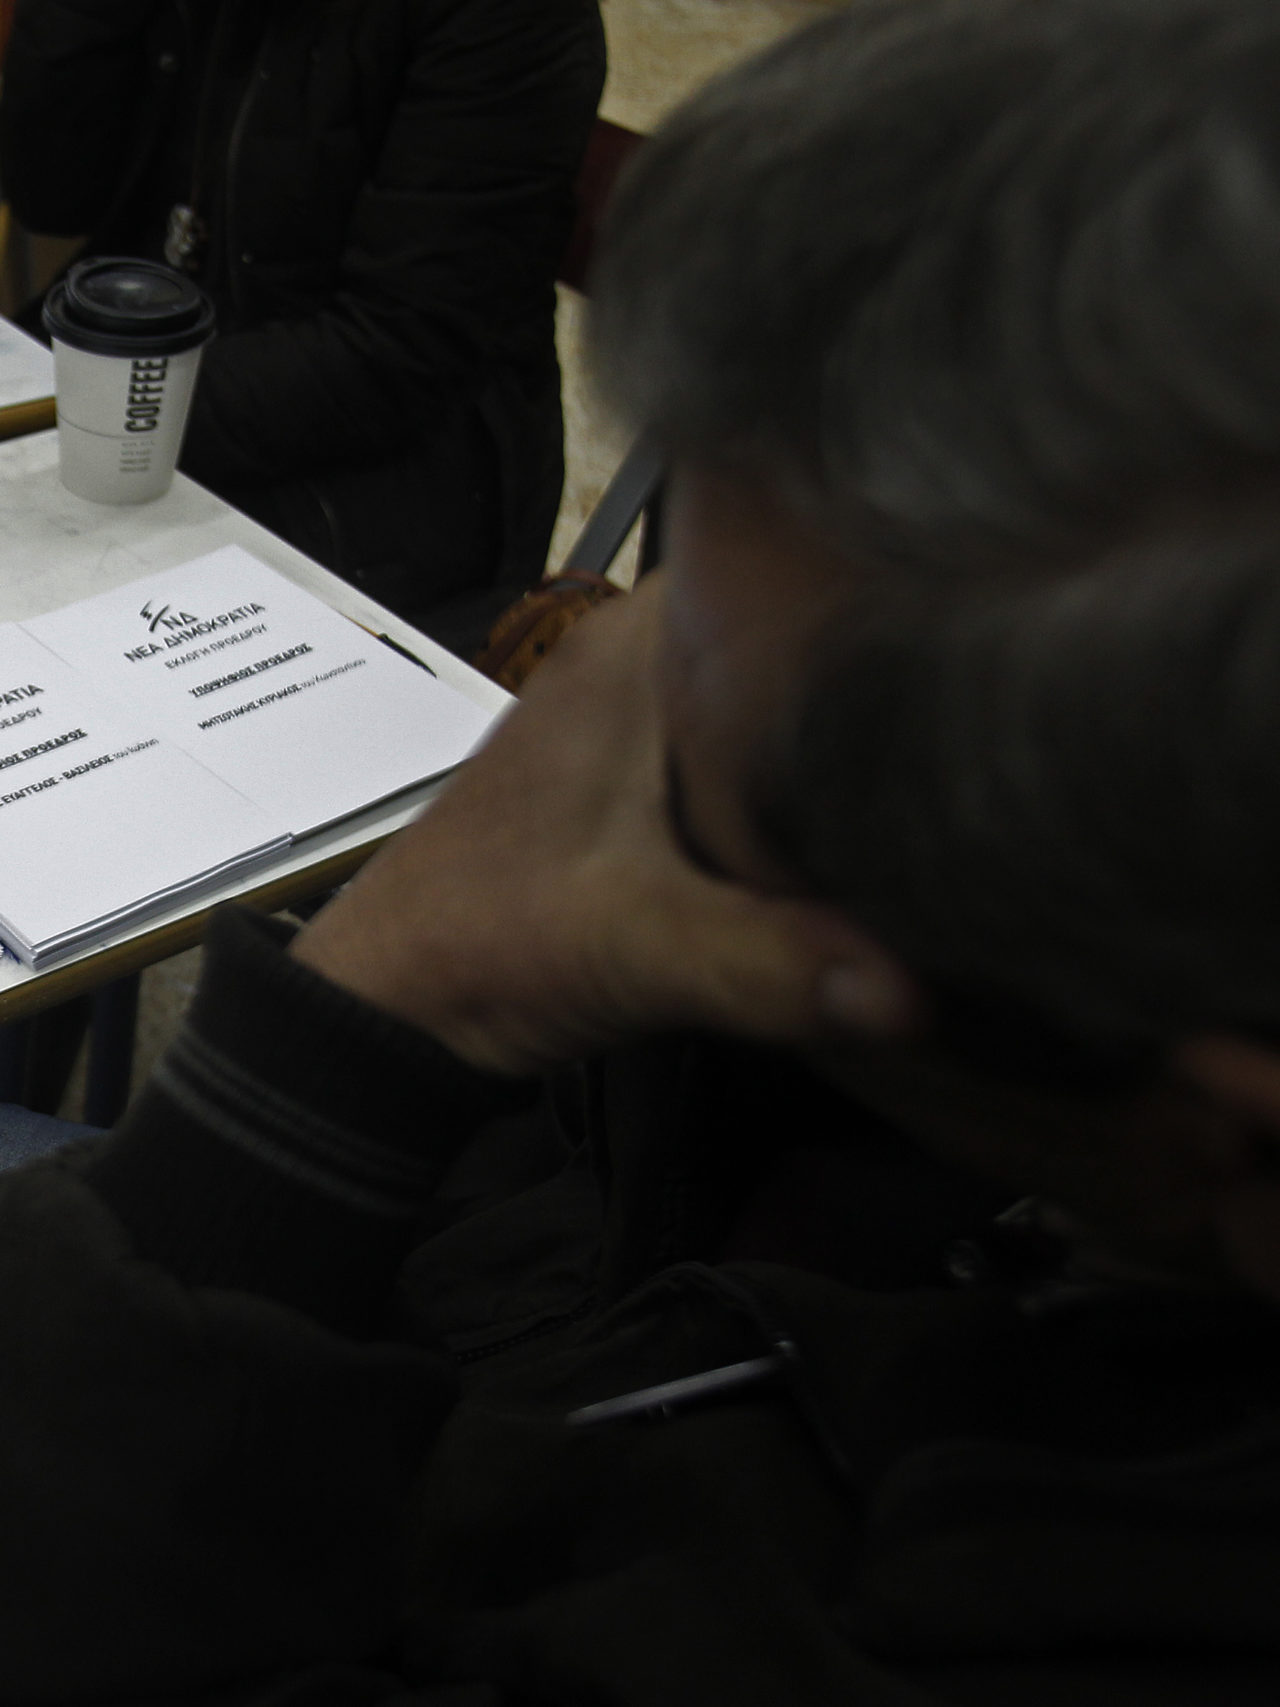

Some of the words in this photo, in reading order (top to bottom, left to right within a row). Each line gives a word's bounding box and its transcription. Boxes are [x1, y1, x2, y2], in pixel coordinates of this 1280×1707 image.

[124, 357, 169, 433] COFFEE
[124, 643, 164, 663] ΝΕΑ
[163, 602, 266, 650] ΔΗΜΟΚΡΑΤΙΑ
[164, 648, 210, 670] ΕΚΛΟΓΗ
[209, 623, 268, 651] ΠΡΟΕΔΡΟΥ
[188, 667, 257, 698] ΥΠΟΨΗΦΙΟΣ
[254, 642, 314, 674] ΠΡΟΕΔΡΟΣ
[22, 727, 88, 761] ΠΡΟΕΔΡΟΣ
[1, 776, 60, 804] ΕΥΑΓΓΕΛΟΣ
